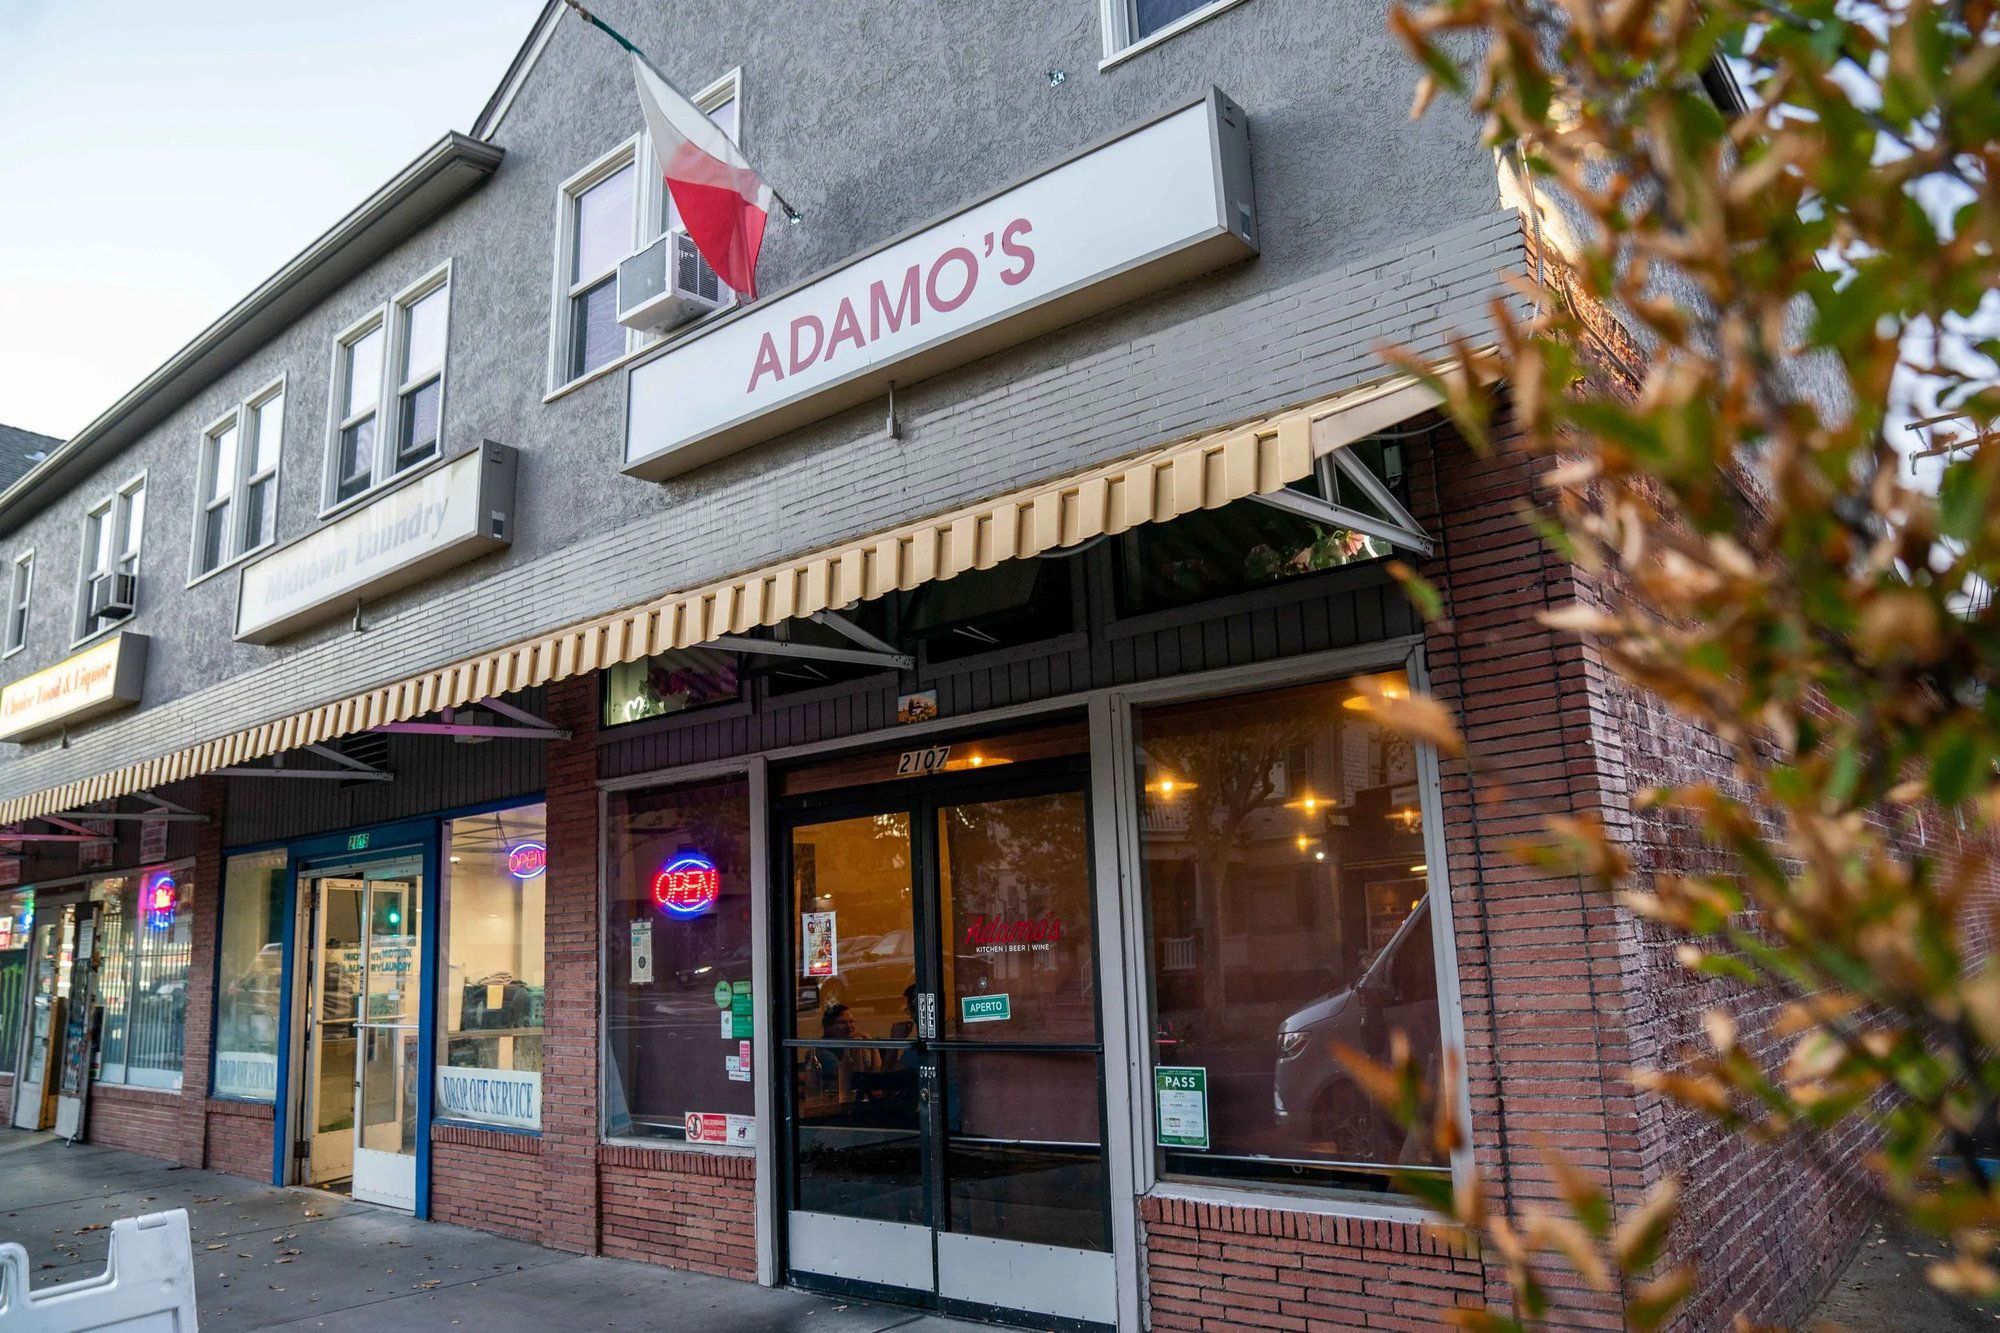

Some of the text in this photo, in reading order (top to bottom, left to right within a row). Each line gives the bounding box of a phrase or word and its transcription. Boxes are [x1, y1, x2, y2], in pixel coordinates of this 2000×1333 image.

[746, 218, 1036, 393] ADAMO'S
[265, 497, 449, 606] Midtown Laundry
[74, 663, 112, 692] Liquor
[900, 748, 949, 774] 2107
[655, 869, 716, 903] OPEN
[1031, 943, 1050, 951] WINE
[382, 961, 412, 972] LAUNDRY
[970, 1001, 1003, 1013] APERTO
[1165, 1076, 1196, 1088] PASS
[443, 1076, 533, 1119] DROP OFF SERVICE
